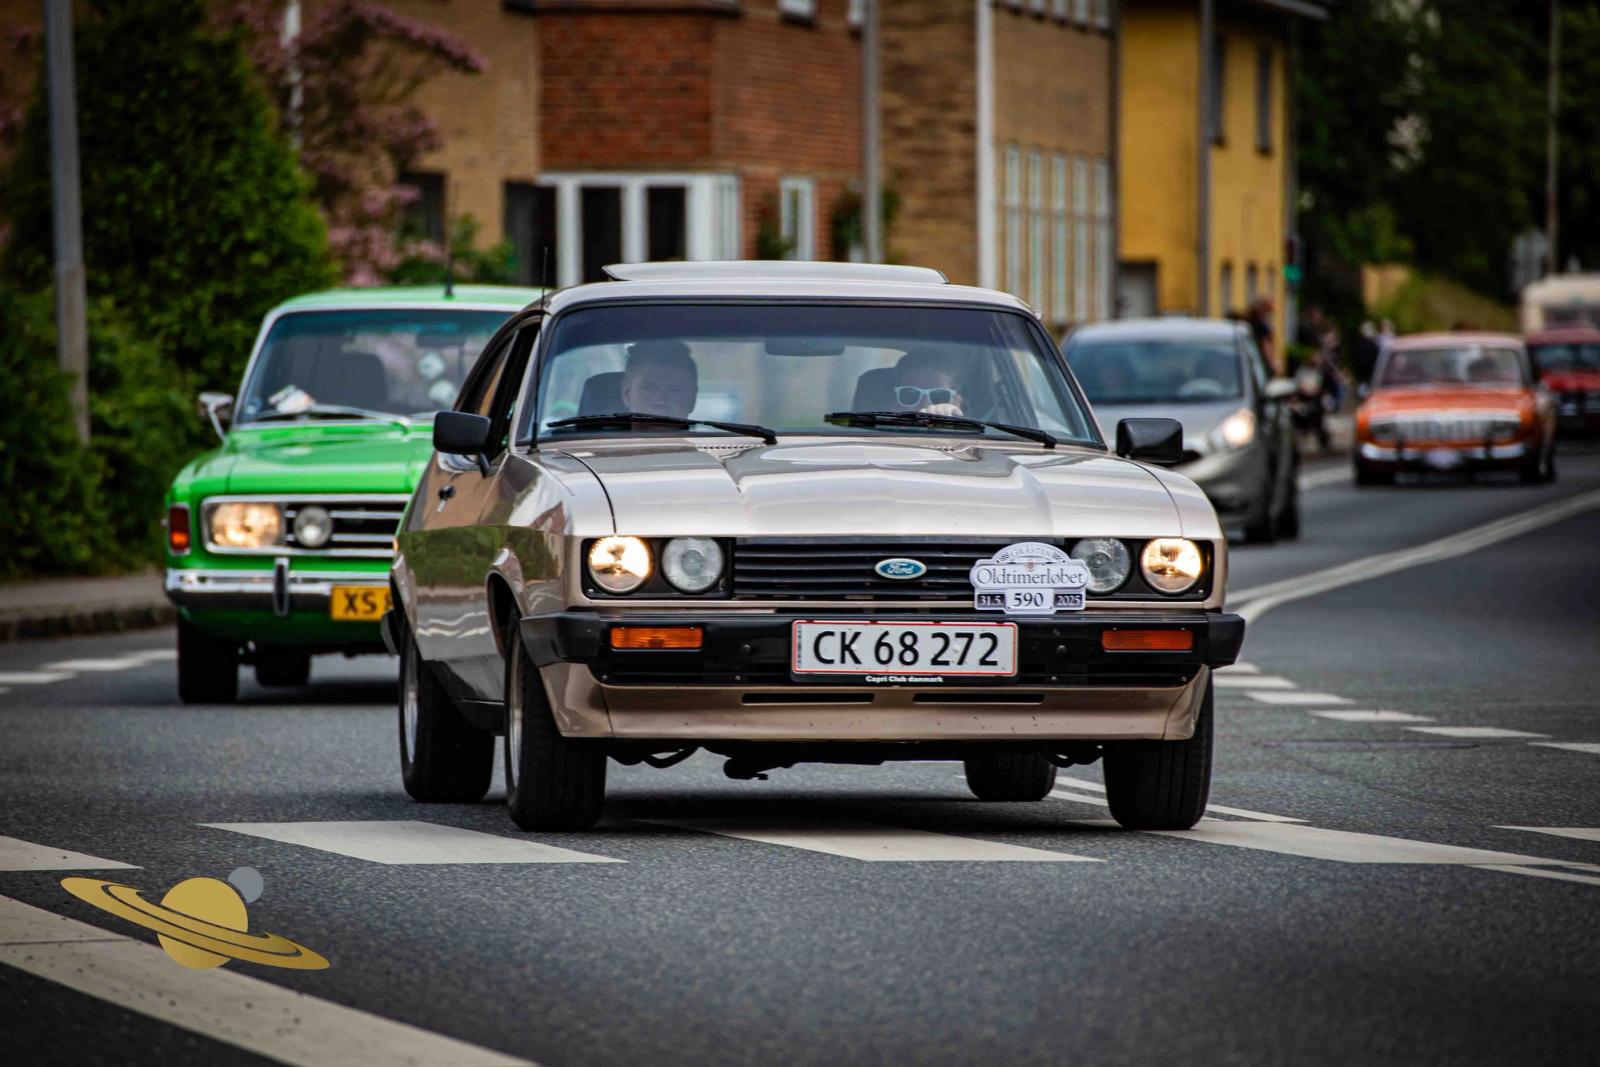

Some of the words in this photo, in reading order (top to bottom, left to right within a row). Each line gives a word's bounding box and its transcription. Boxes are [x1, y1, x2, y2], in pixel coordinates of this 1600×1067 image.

[887, 562, 914, 574] Ford
[976, 568, 1085, 586] Oldtimerløbet
[343, 591, 378, 616] XS
[1013, 592, 1044, 607] 590
[1057, 595, 1081, 606] 2025
[813, 630, 862, 665] CK
[874, 630, 920, 666] 68
[930, 632, 998, 667] 272
[865, 675, 888, 684] Capri
[889, 675, 907, 683] Club
